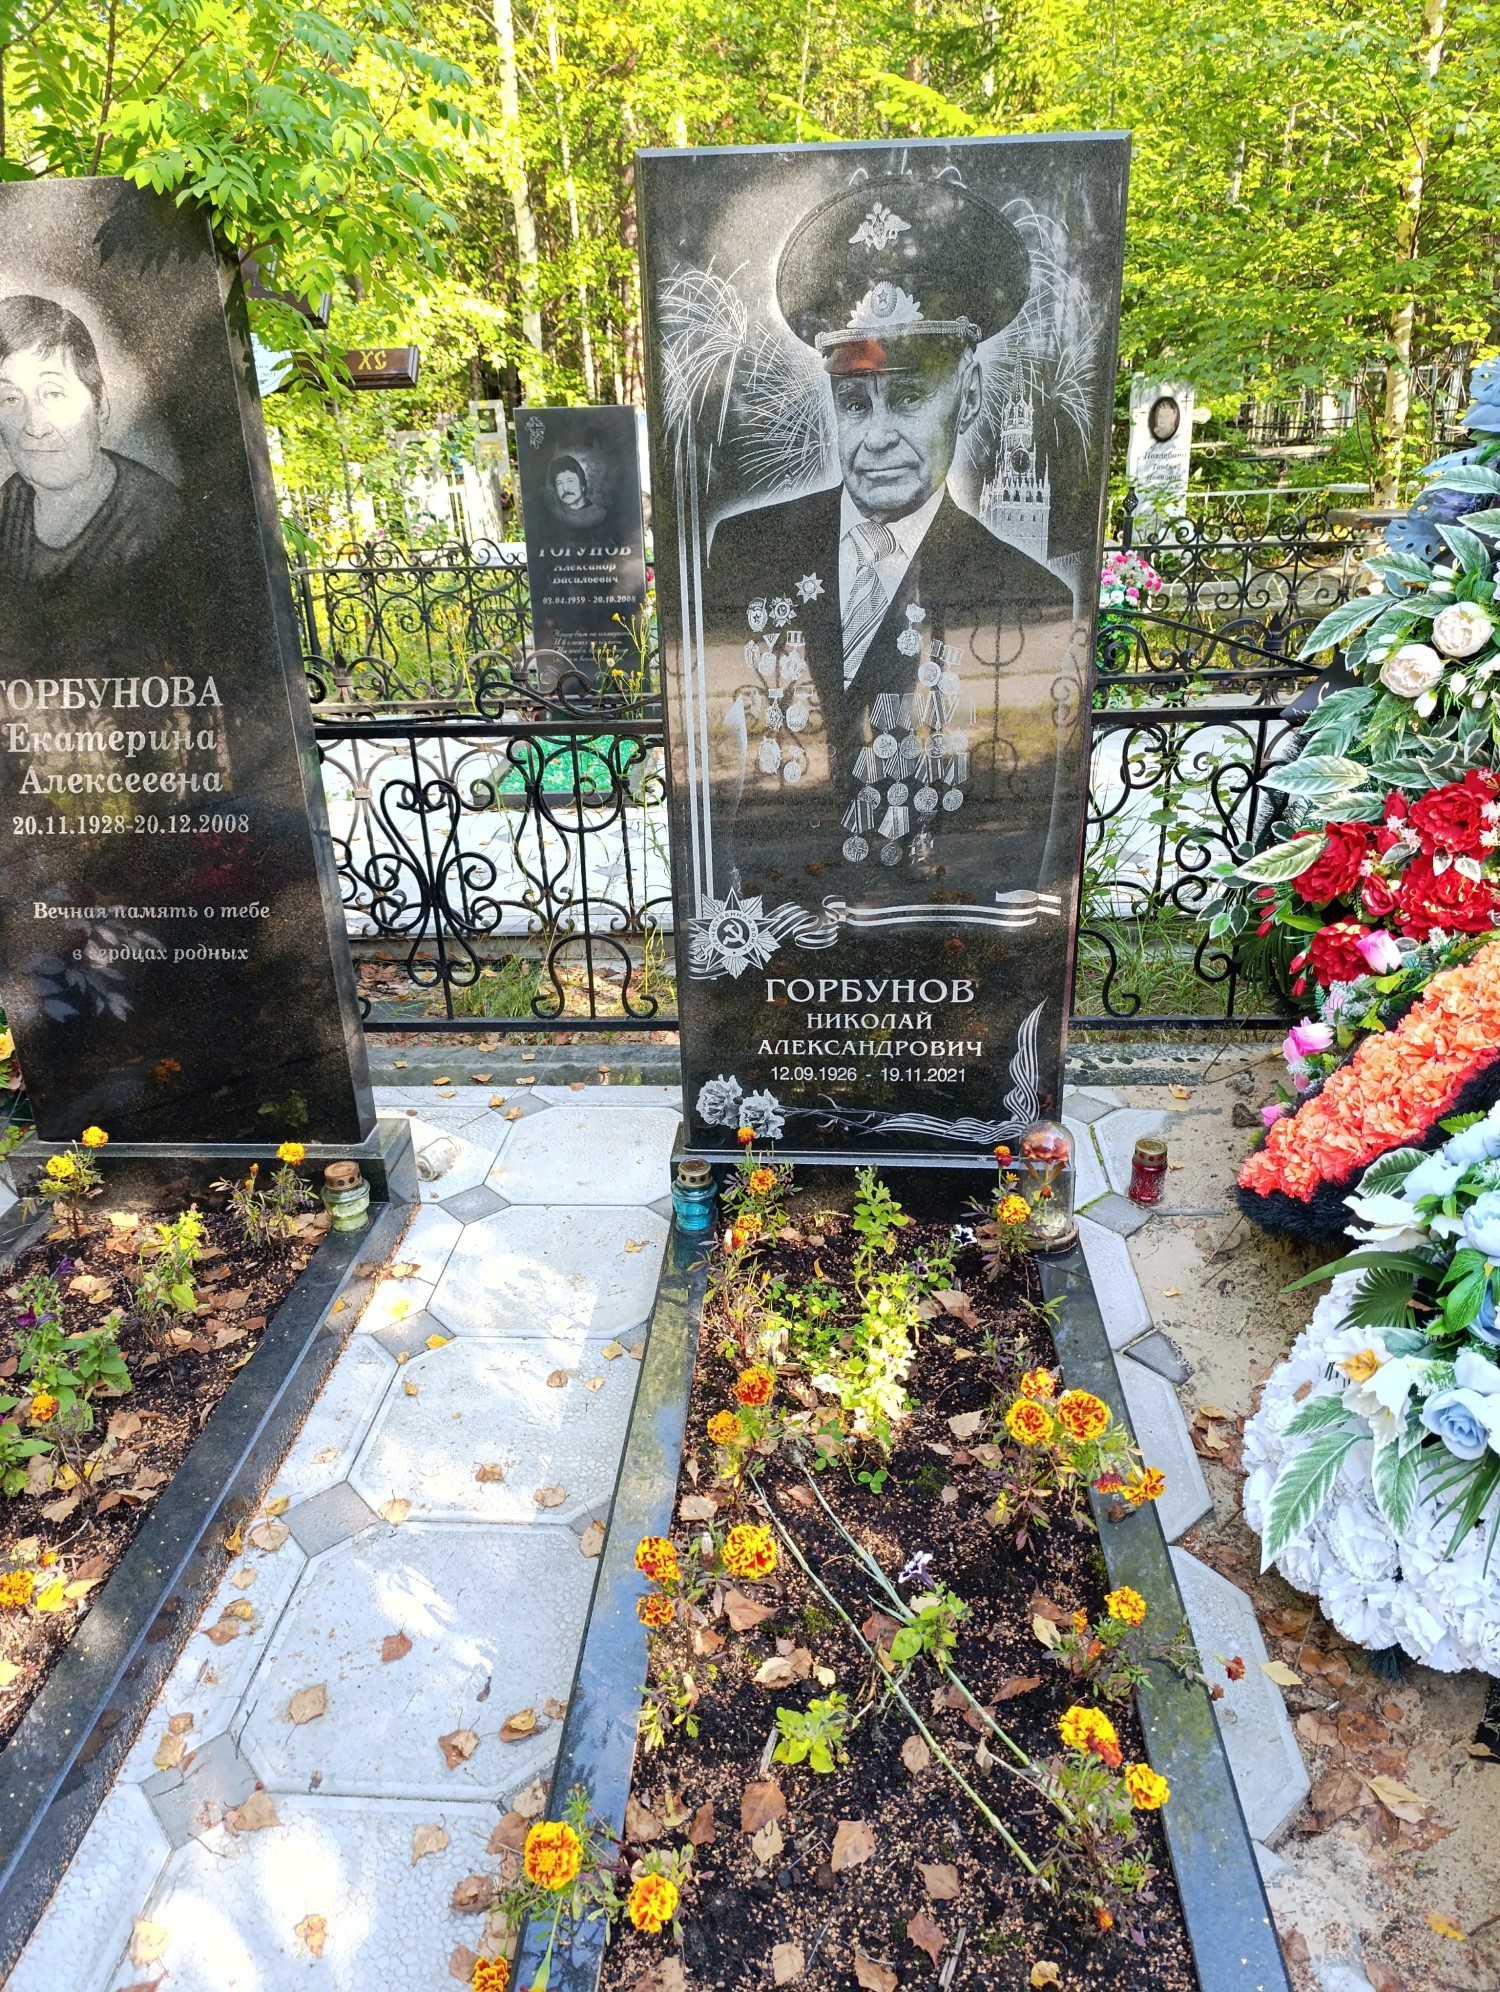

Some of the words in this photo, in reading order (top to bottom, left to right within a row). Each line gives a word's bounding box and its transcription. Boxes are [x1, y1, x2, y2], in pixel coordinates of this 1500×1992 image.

[6, 722, 217, 757] Екатерина
[19, 766, 223, 794] Алексеевна
[12, 814, 250, 835] 20.11.1928-20.12.2008
[33, 902, 107, 919] Вечная
[112, 906, 198, 919] память
[203, 908, 215, 919] о
[220, 901, 271, 918] тебе
[72, 952, 82, 961] в
[172, 945, 249, 963] родных
[765, 978, 975, 1003] ГОРБУНОВ
[806, 1010, 933, 1030] НИКОЛАЙ
[757, 1038, 983, 1059] АЛЕКСАНДРОВИЧ
[771, 1066, 858, 1081] 12.09.1926
[880, 1067, 966, 1083] 19.11.2021
